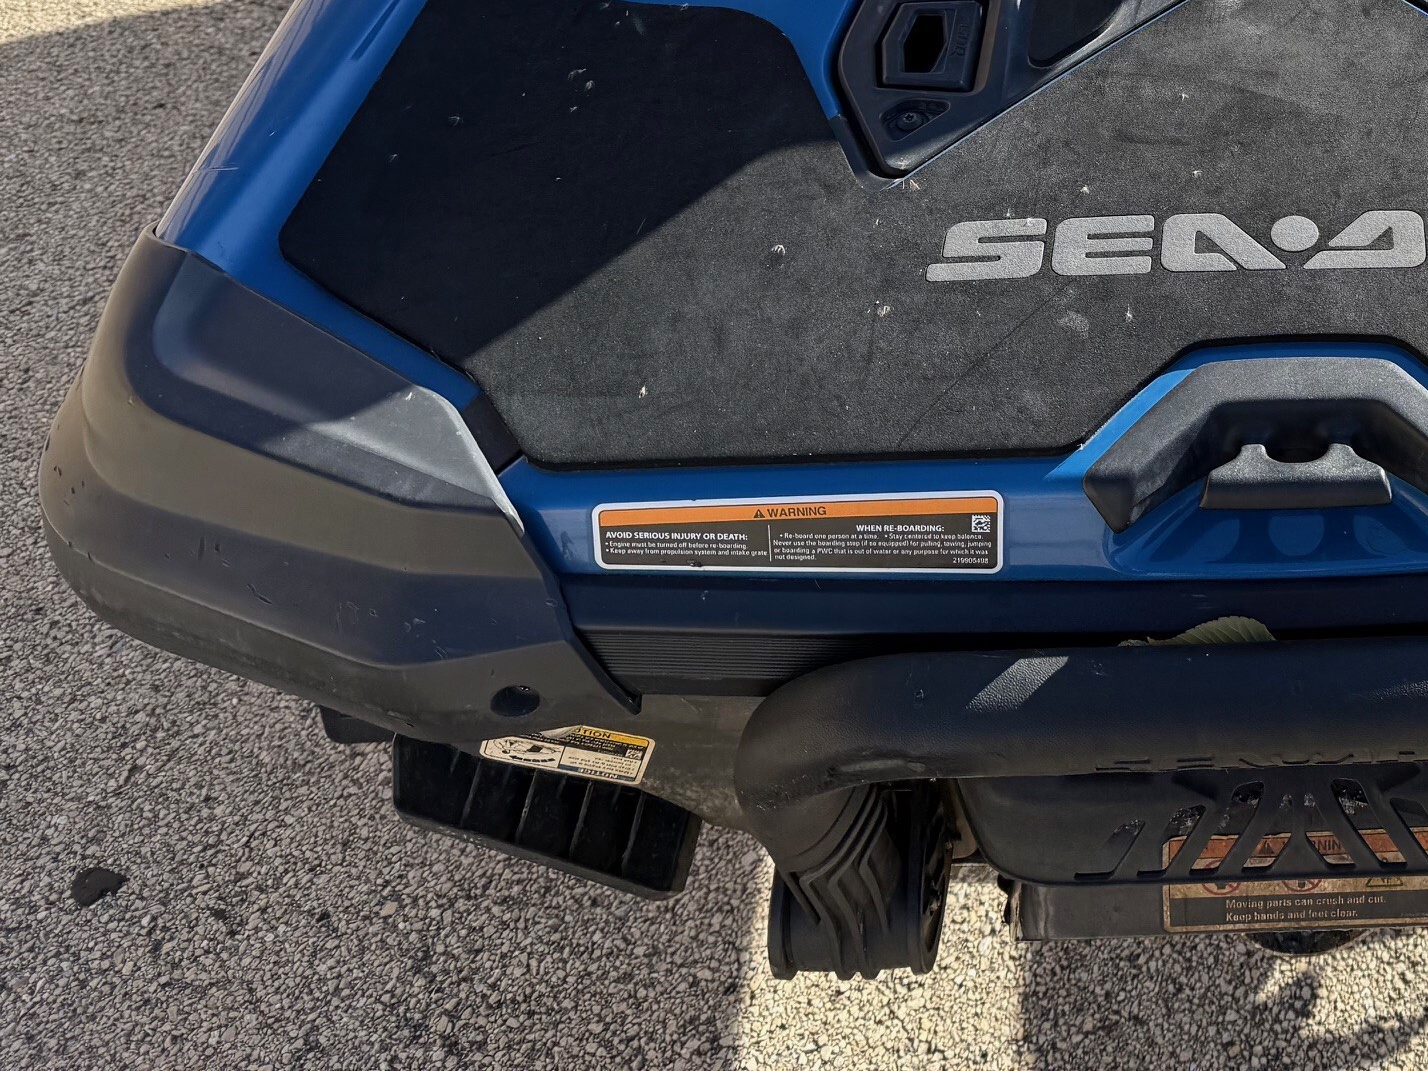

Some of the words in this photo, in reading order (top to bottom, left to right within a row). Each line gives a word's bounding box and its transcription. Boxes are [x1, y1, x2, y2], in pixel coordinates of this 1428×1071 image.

[767, 506, 827, 518] WARNING
[884, 524, 945, 532] RE-BOARDING:
[1226, 899, 1263, 910] Moving
[1266, 898, 1292, 910] parts
[1316, 896, 1344, 905] crush
[1347, 895, 1365, 904] and
[1226, 912, 1251, 922] Keep
[1254, 911, 1284, 920] hands
[1287, 910, 1305, 919] and
[1308, 909, 1328, 918] feet
